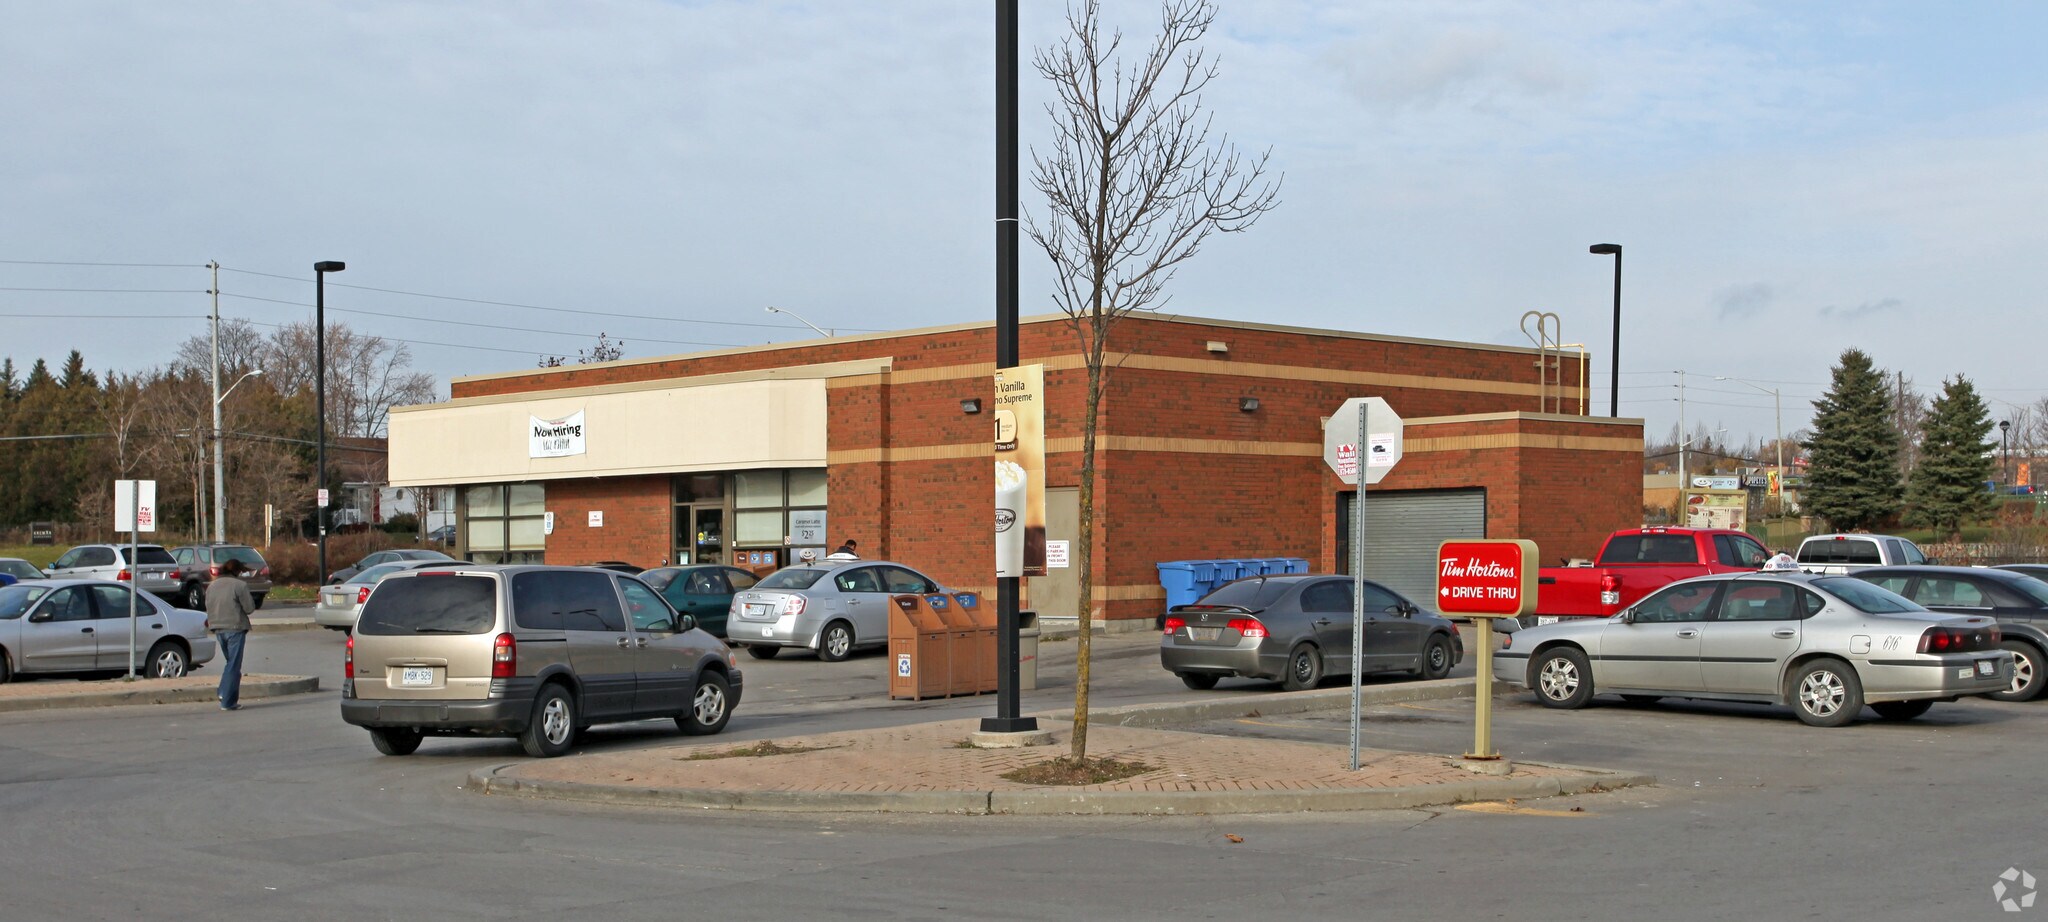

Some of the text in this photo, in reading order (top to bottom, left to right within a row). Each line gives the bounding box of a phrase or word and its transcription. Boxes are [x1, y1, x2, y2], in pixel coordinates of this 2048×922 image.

[1000, 381, 1025, 393] Vanilla
[1004, 393, 1032, 405] Supreme
[553, 424, 581, 437] Hiring
[1337, 443, 1356, 452] TV
[1338, 451, 1356, 459] Wall
[1441, 557, 1514, 577] Tim Hortons
[1452, 587, 1516, 599] DRIVE THRU
